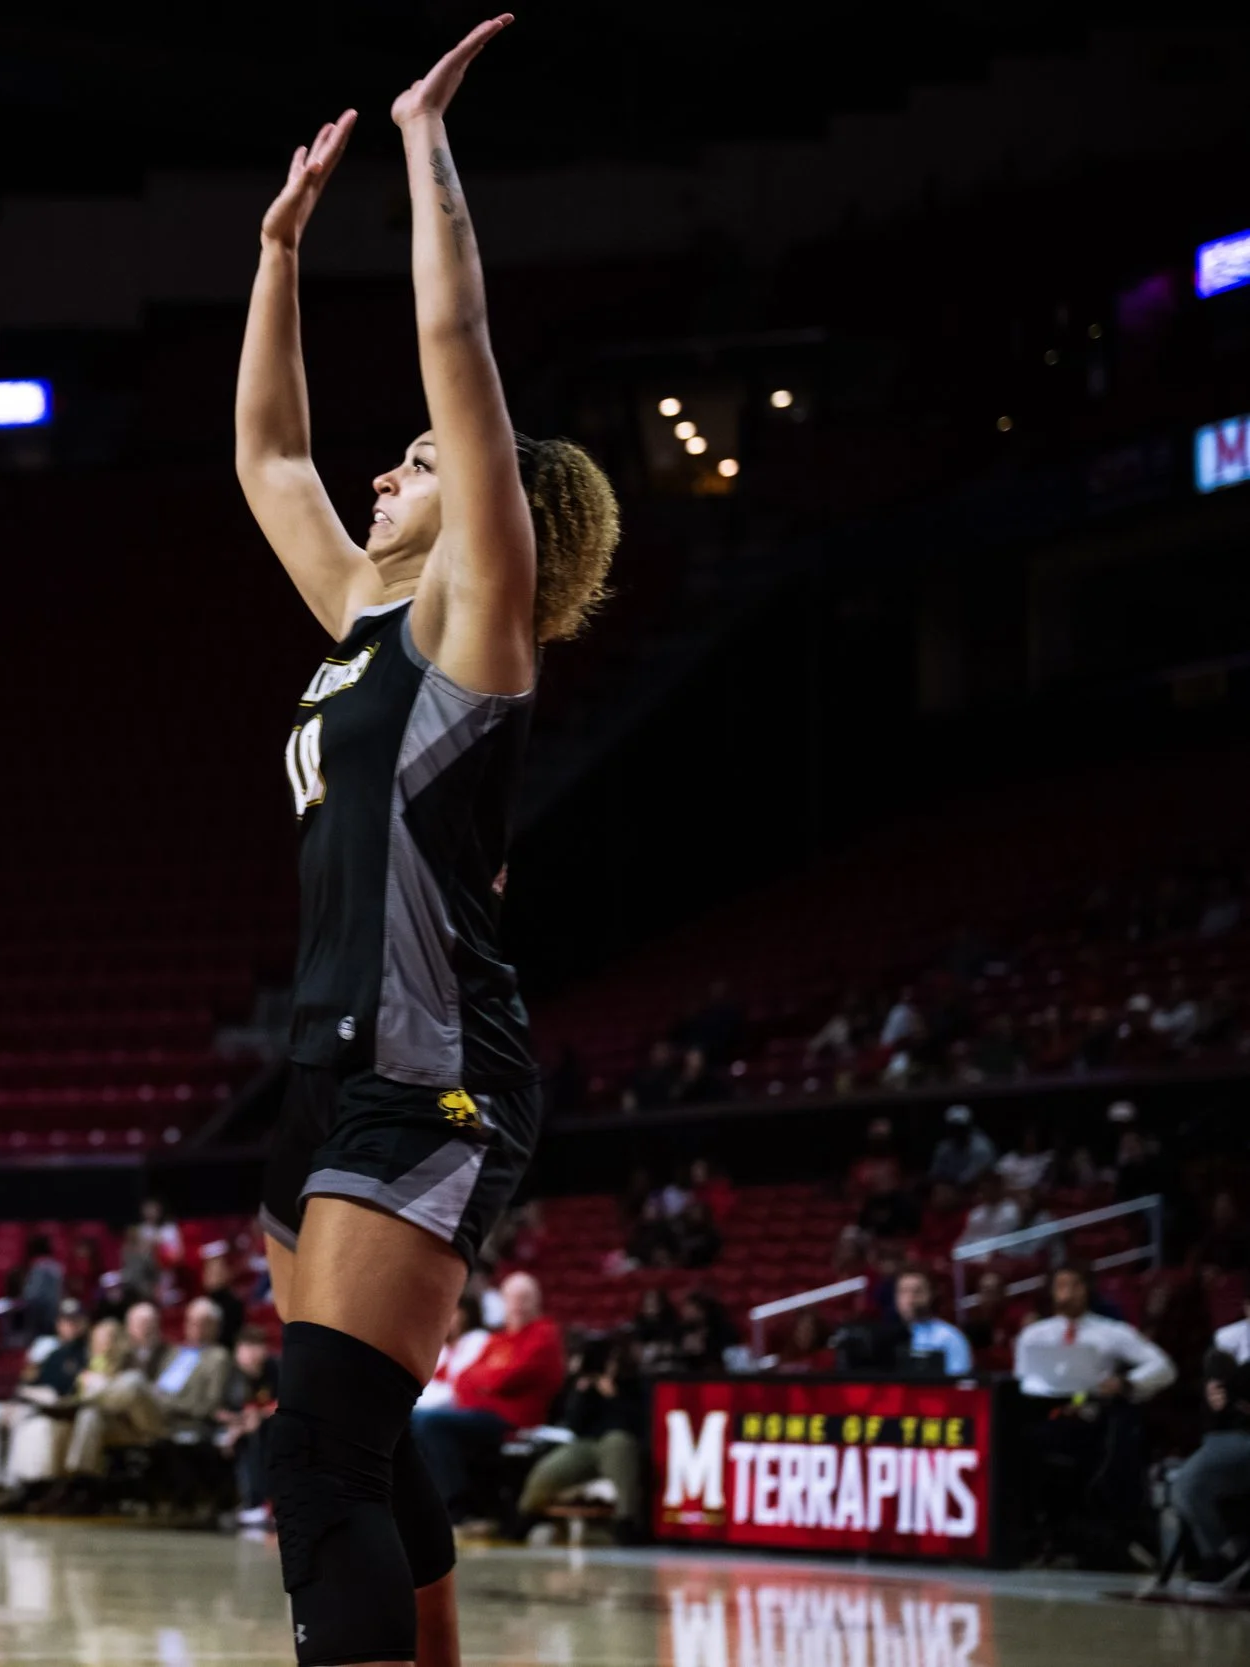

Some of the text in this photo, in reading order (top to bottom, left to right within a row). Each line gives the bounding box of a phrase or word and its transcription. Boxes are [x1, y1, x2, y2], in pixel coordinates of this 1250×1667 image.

[662, 1409, 729, 1511] M
[742, 1412, 966, 1446] HOME OF THE
[727, 1441, 979, 1538] TERRAPINS
